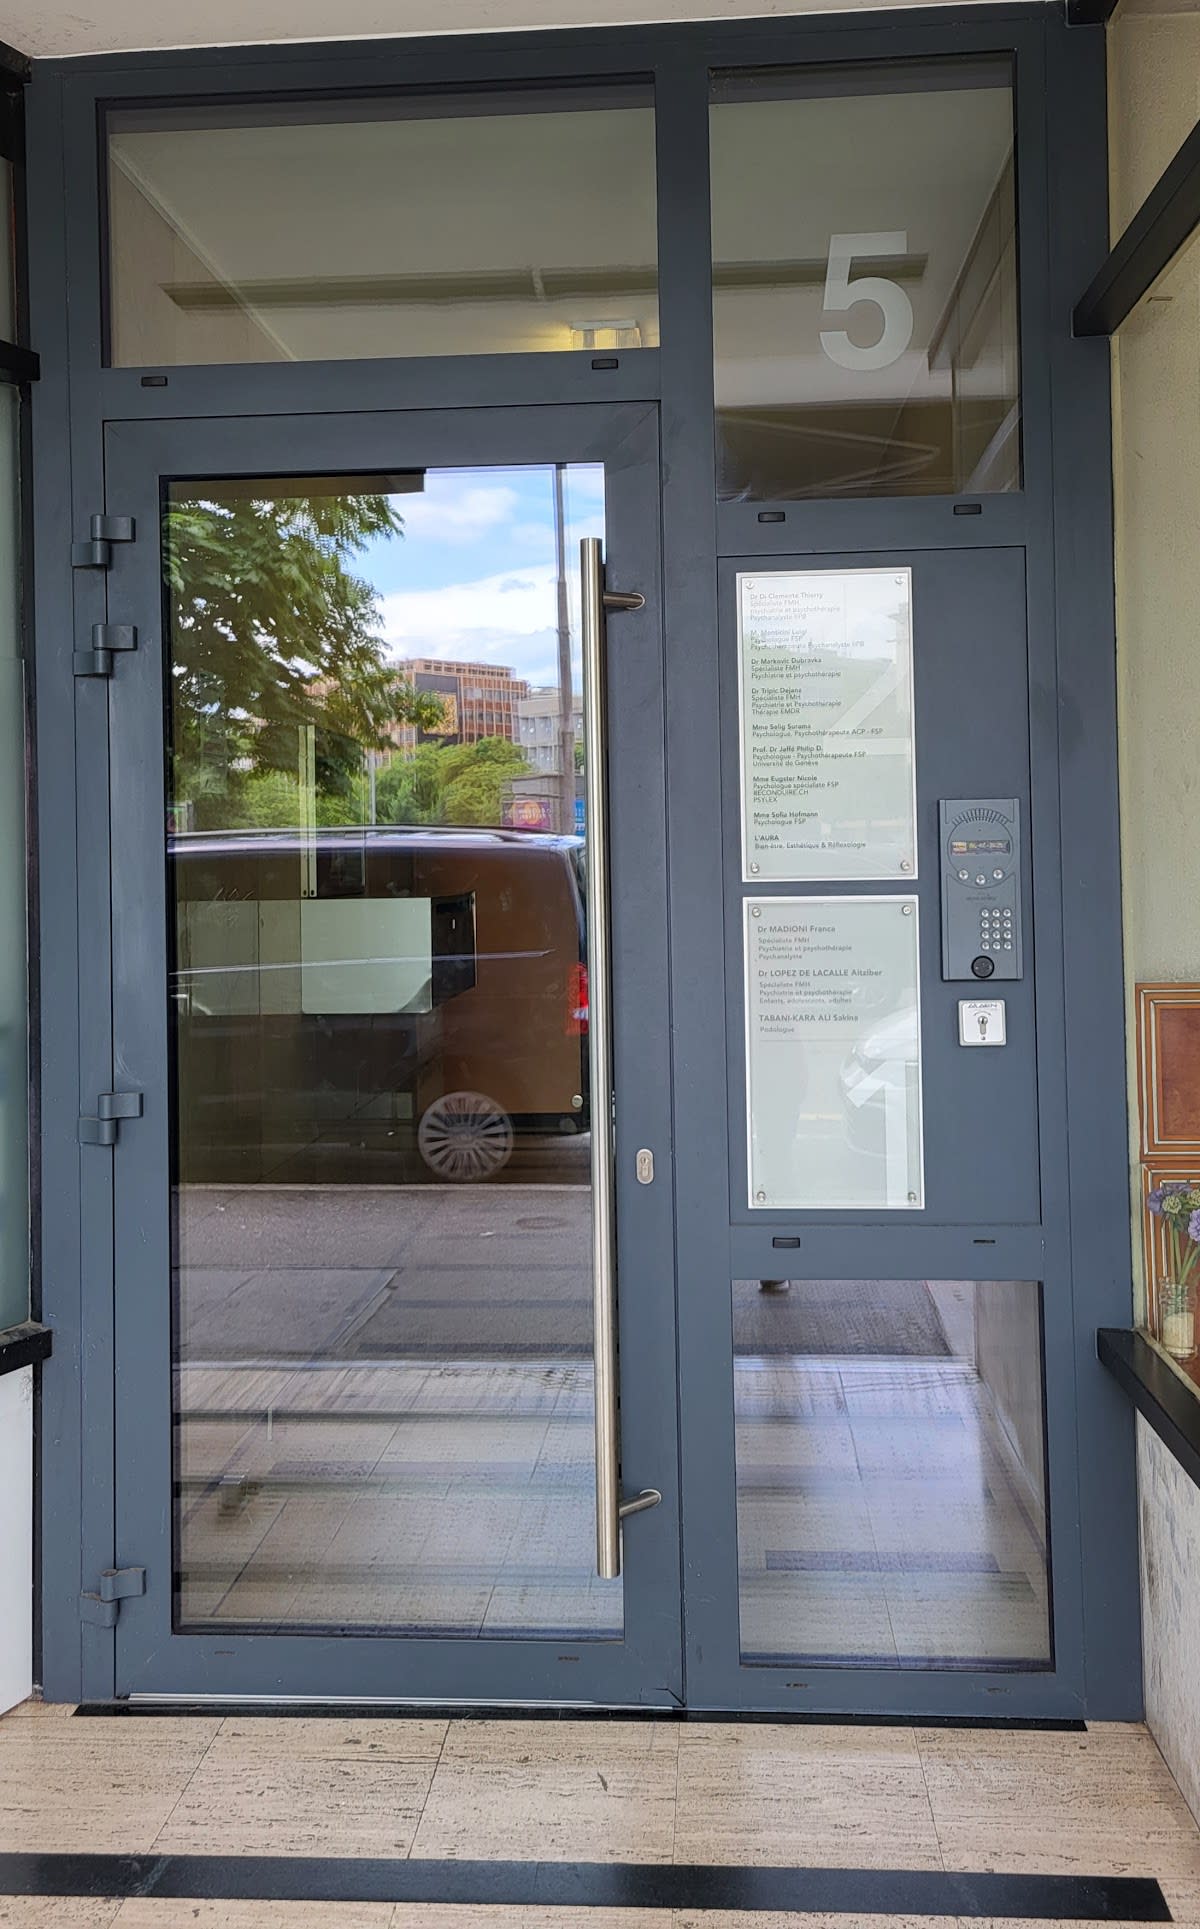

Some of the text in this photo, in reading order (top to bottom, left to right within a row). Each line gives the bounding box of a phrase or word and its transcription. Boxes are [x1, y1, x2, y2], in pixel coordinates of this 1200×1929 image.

[819, 231, 913, 371] 5
[800, 592, 823, 600] Thierry
[780, 687, 802, 695] Dejana
[796, 745, 815, 753] Philip
[752, 753, 791, 761] Psychologue
[770, 775, 796, 783] Eugster
[753, 782, 792, 790] Psychologue
[758, 969, 768, 977] Dr
